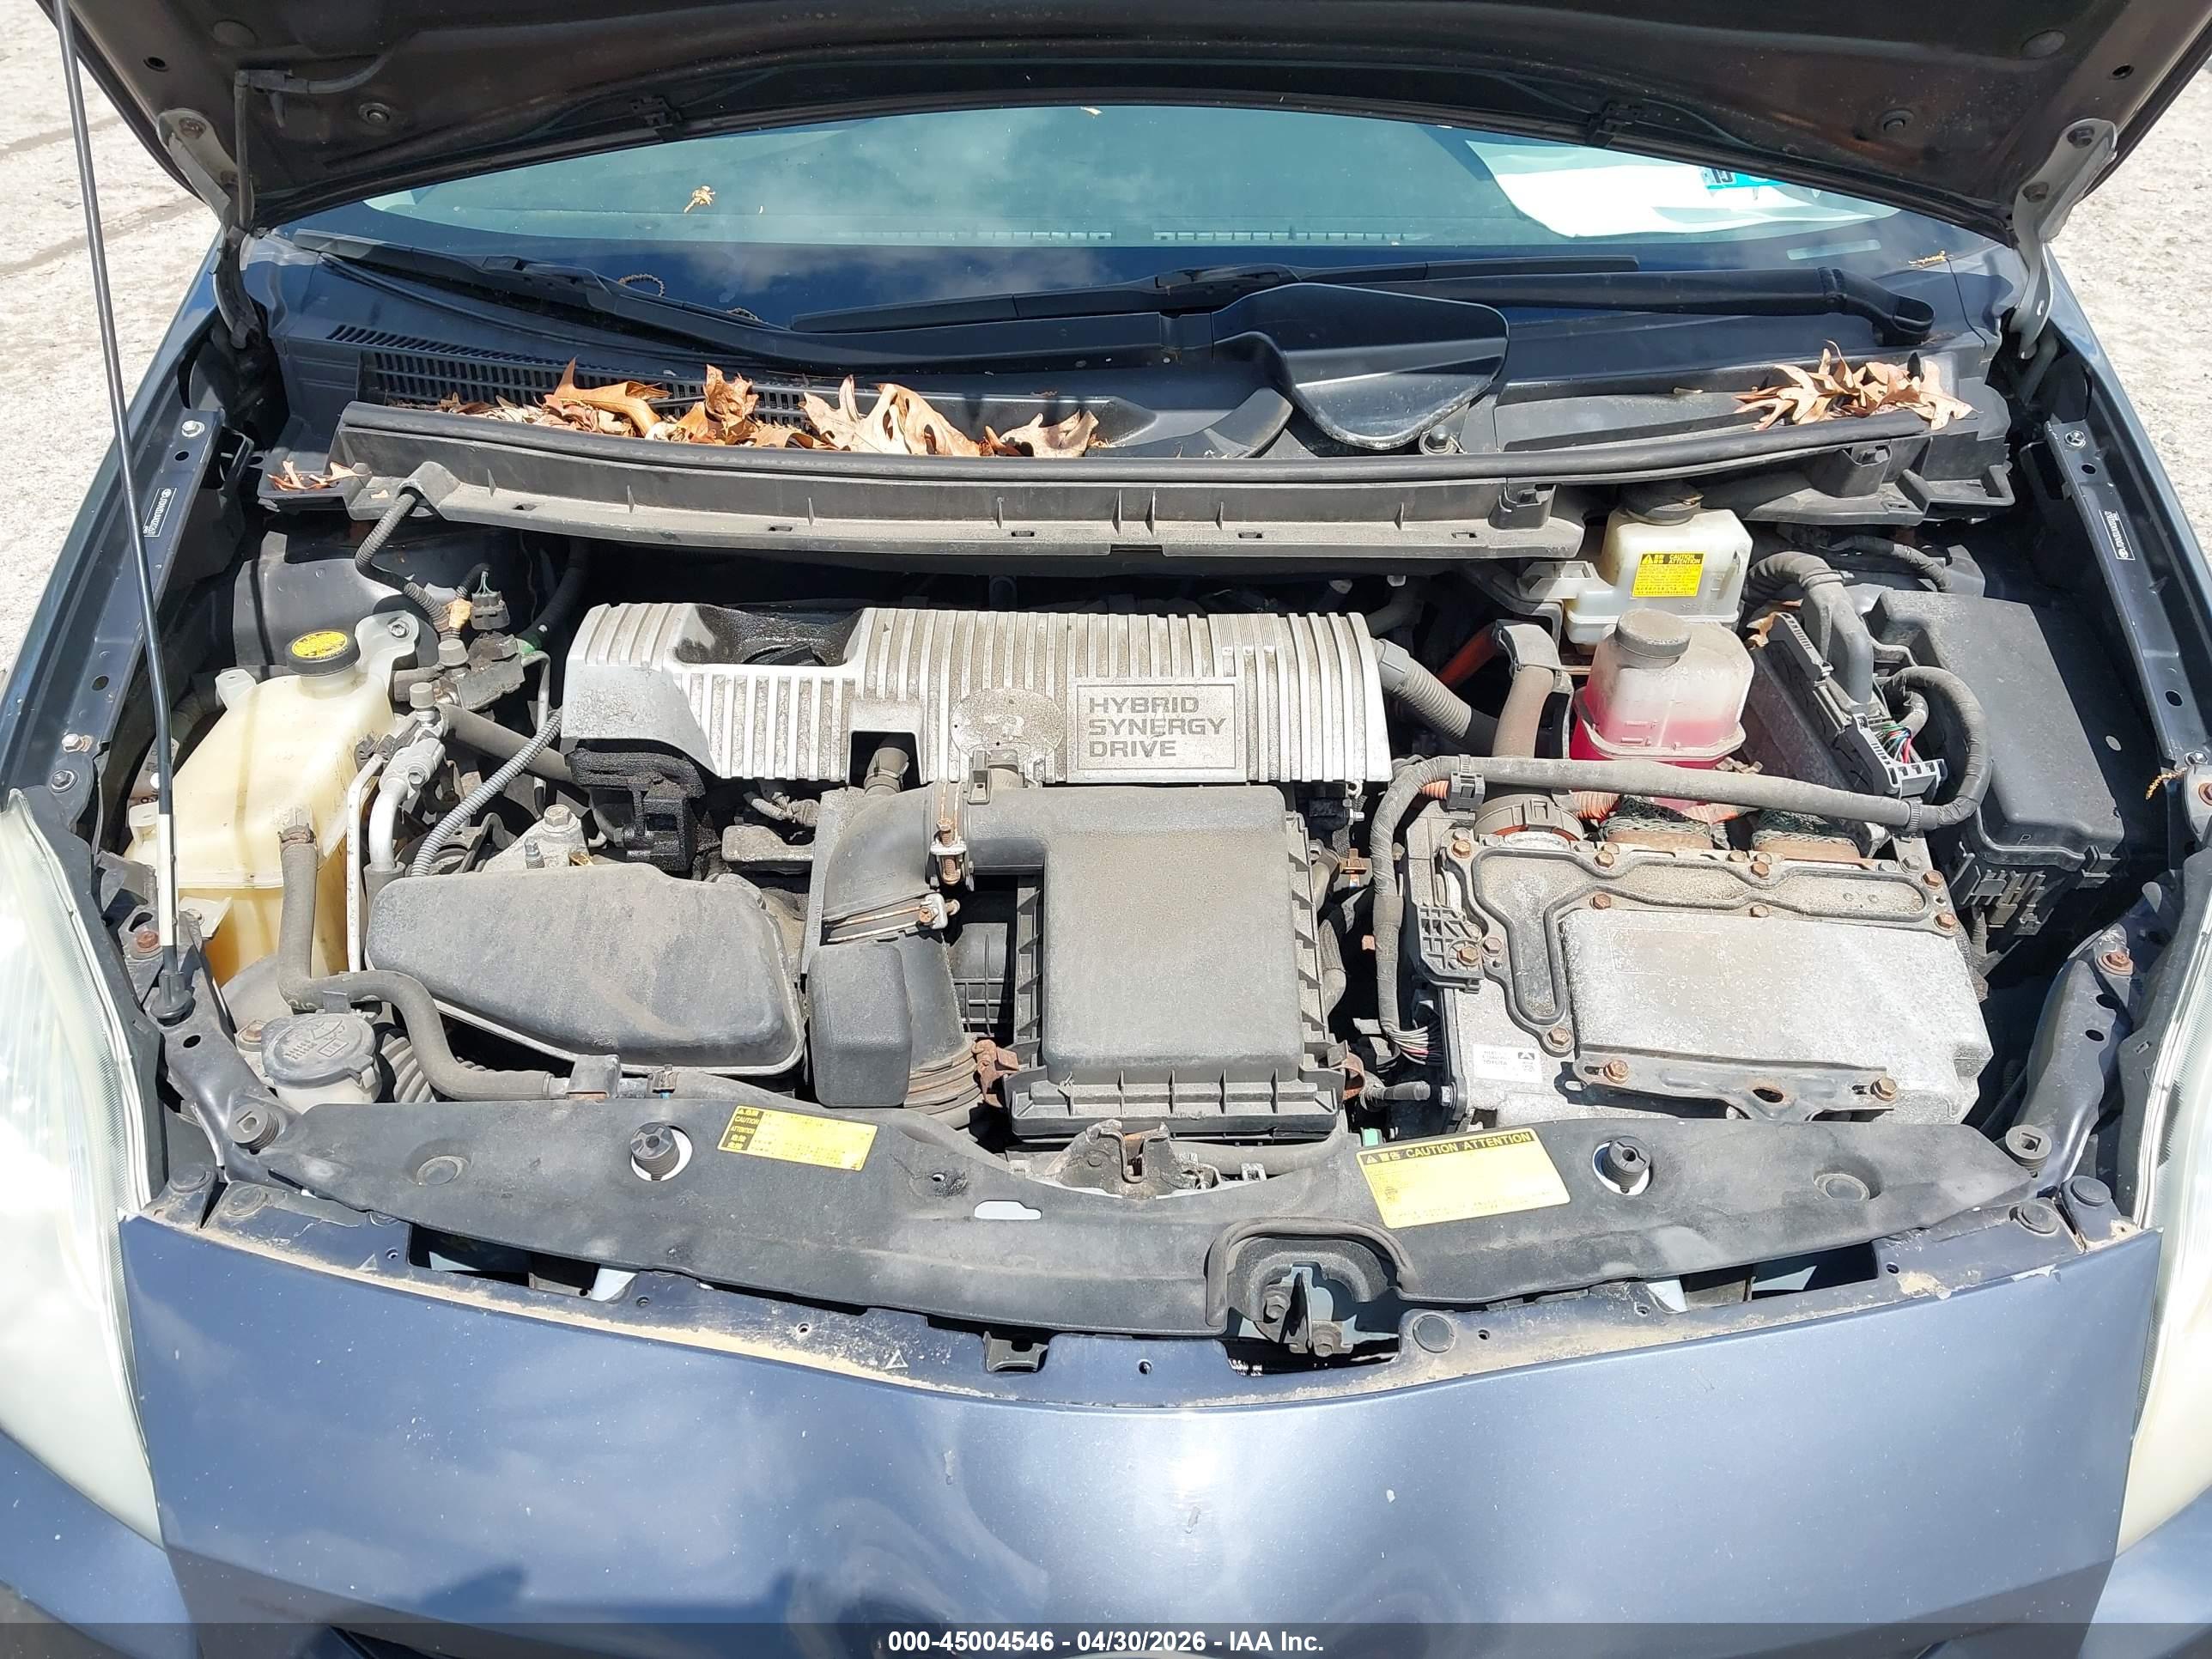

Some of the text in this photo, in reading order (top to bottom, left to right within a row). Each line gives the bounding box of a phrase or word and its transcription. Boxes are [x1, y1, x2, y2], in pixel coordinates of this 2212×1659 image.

[1089, 696, 1199, 714] HYBRID
[1089, 718, 1227, 736] SYNERGY
[1089, 740, 1176, 757] DRIVE
[734, 1115, 759, 1125] CAUTION
[1406, 1142, 1459, 1158] CAUTION
[1463, 1132, 1531, 1151] ATTENTION
